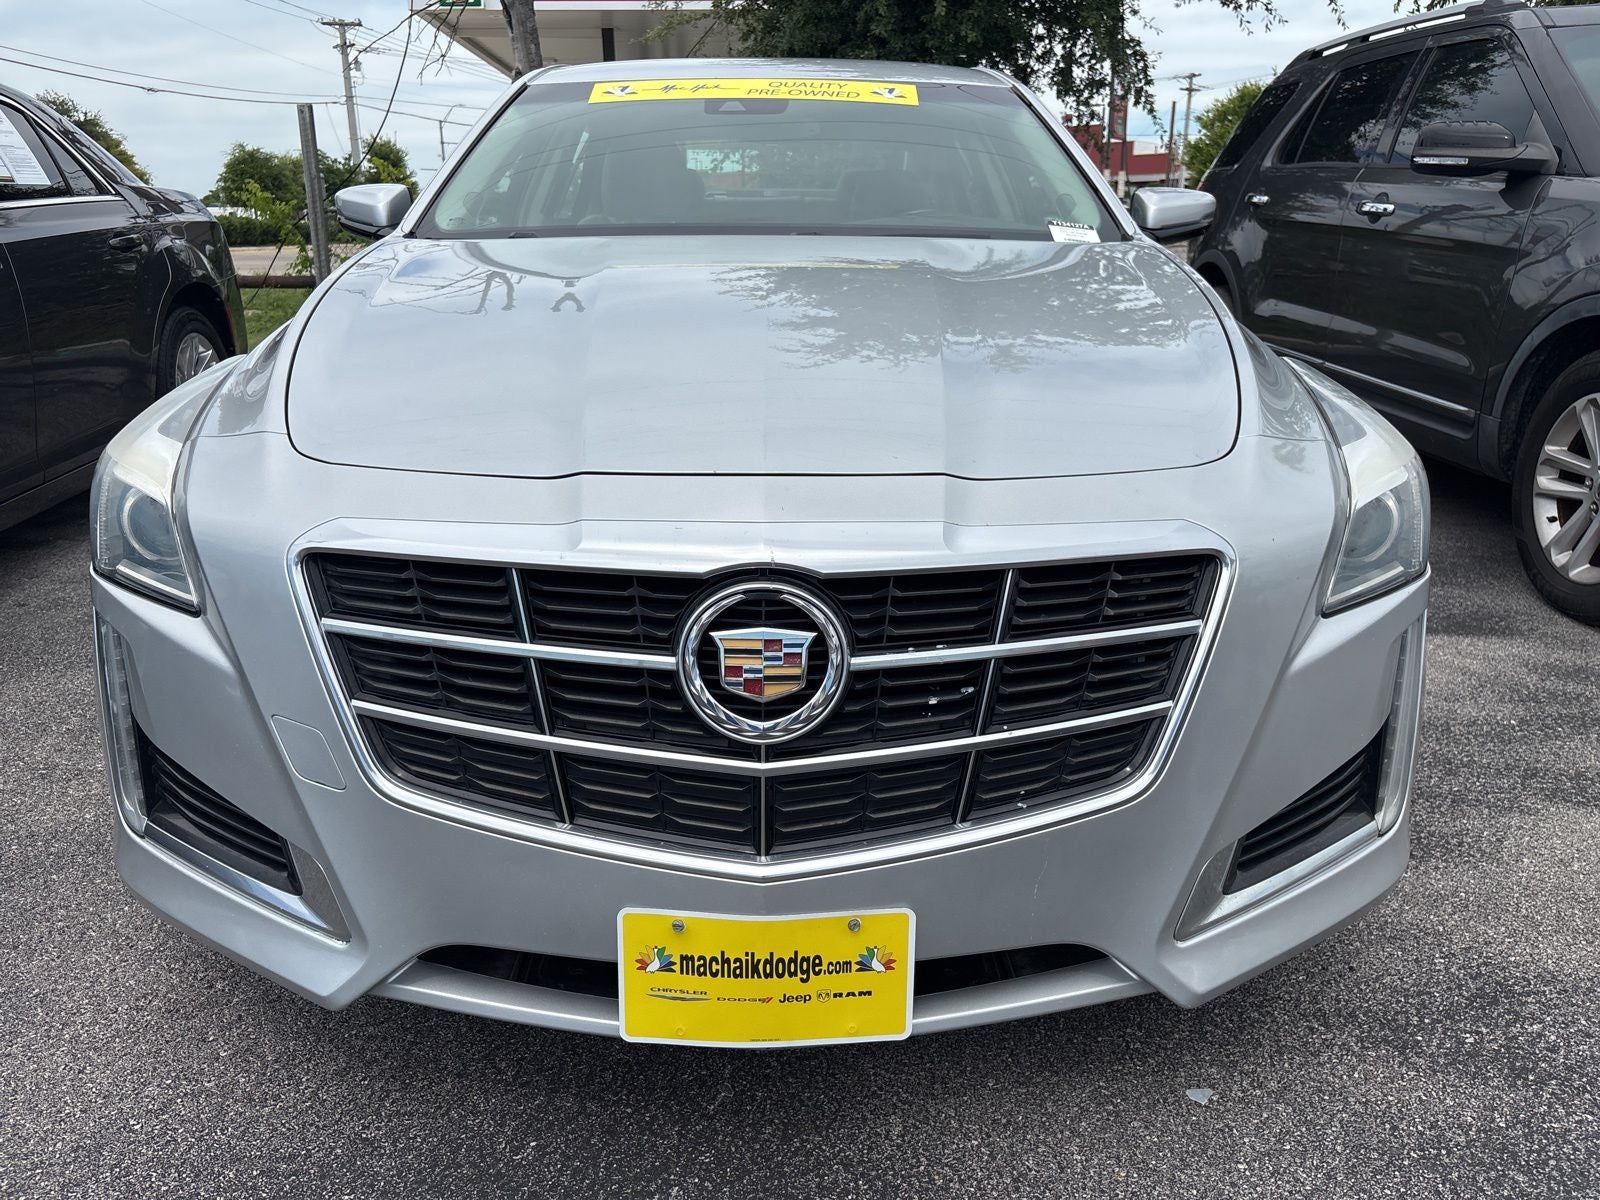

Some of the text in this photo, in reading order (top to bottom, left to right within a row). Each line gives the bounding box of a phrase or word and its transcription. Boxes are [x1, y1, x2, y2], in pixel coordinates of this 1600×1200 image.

[768, 81, 849, 90] QUALITY
[746, 88, 861, 99] PRE-OWNED
[679, 950, 852, 983] machaikdodge.com
[650, 987, 707, 996] CHRYSLER
[779, 993, 812, 1004] Jeep
[833, 990, 873, 999] RAM
